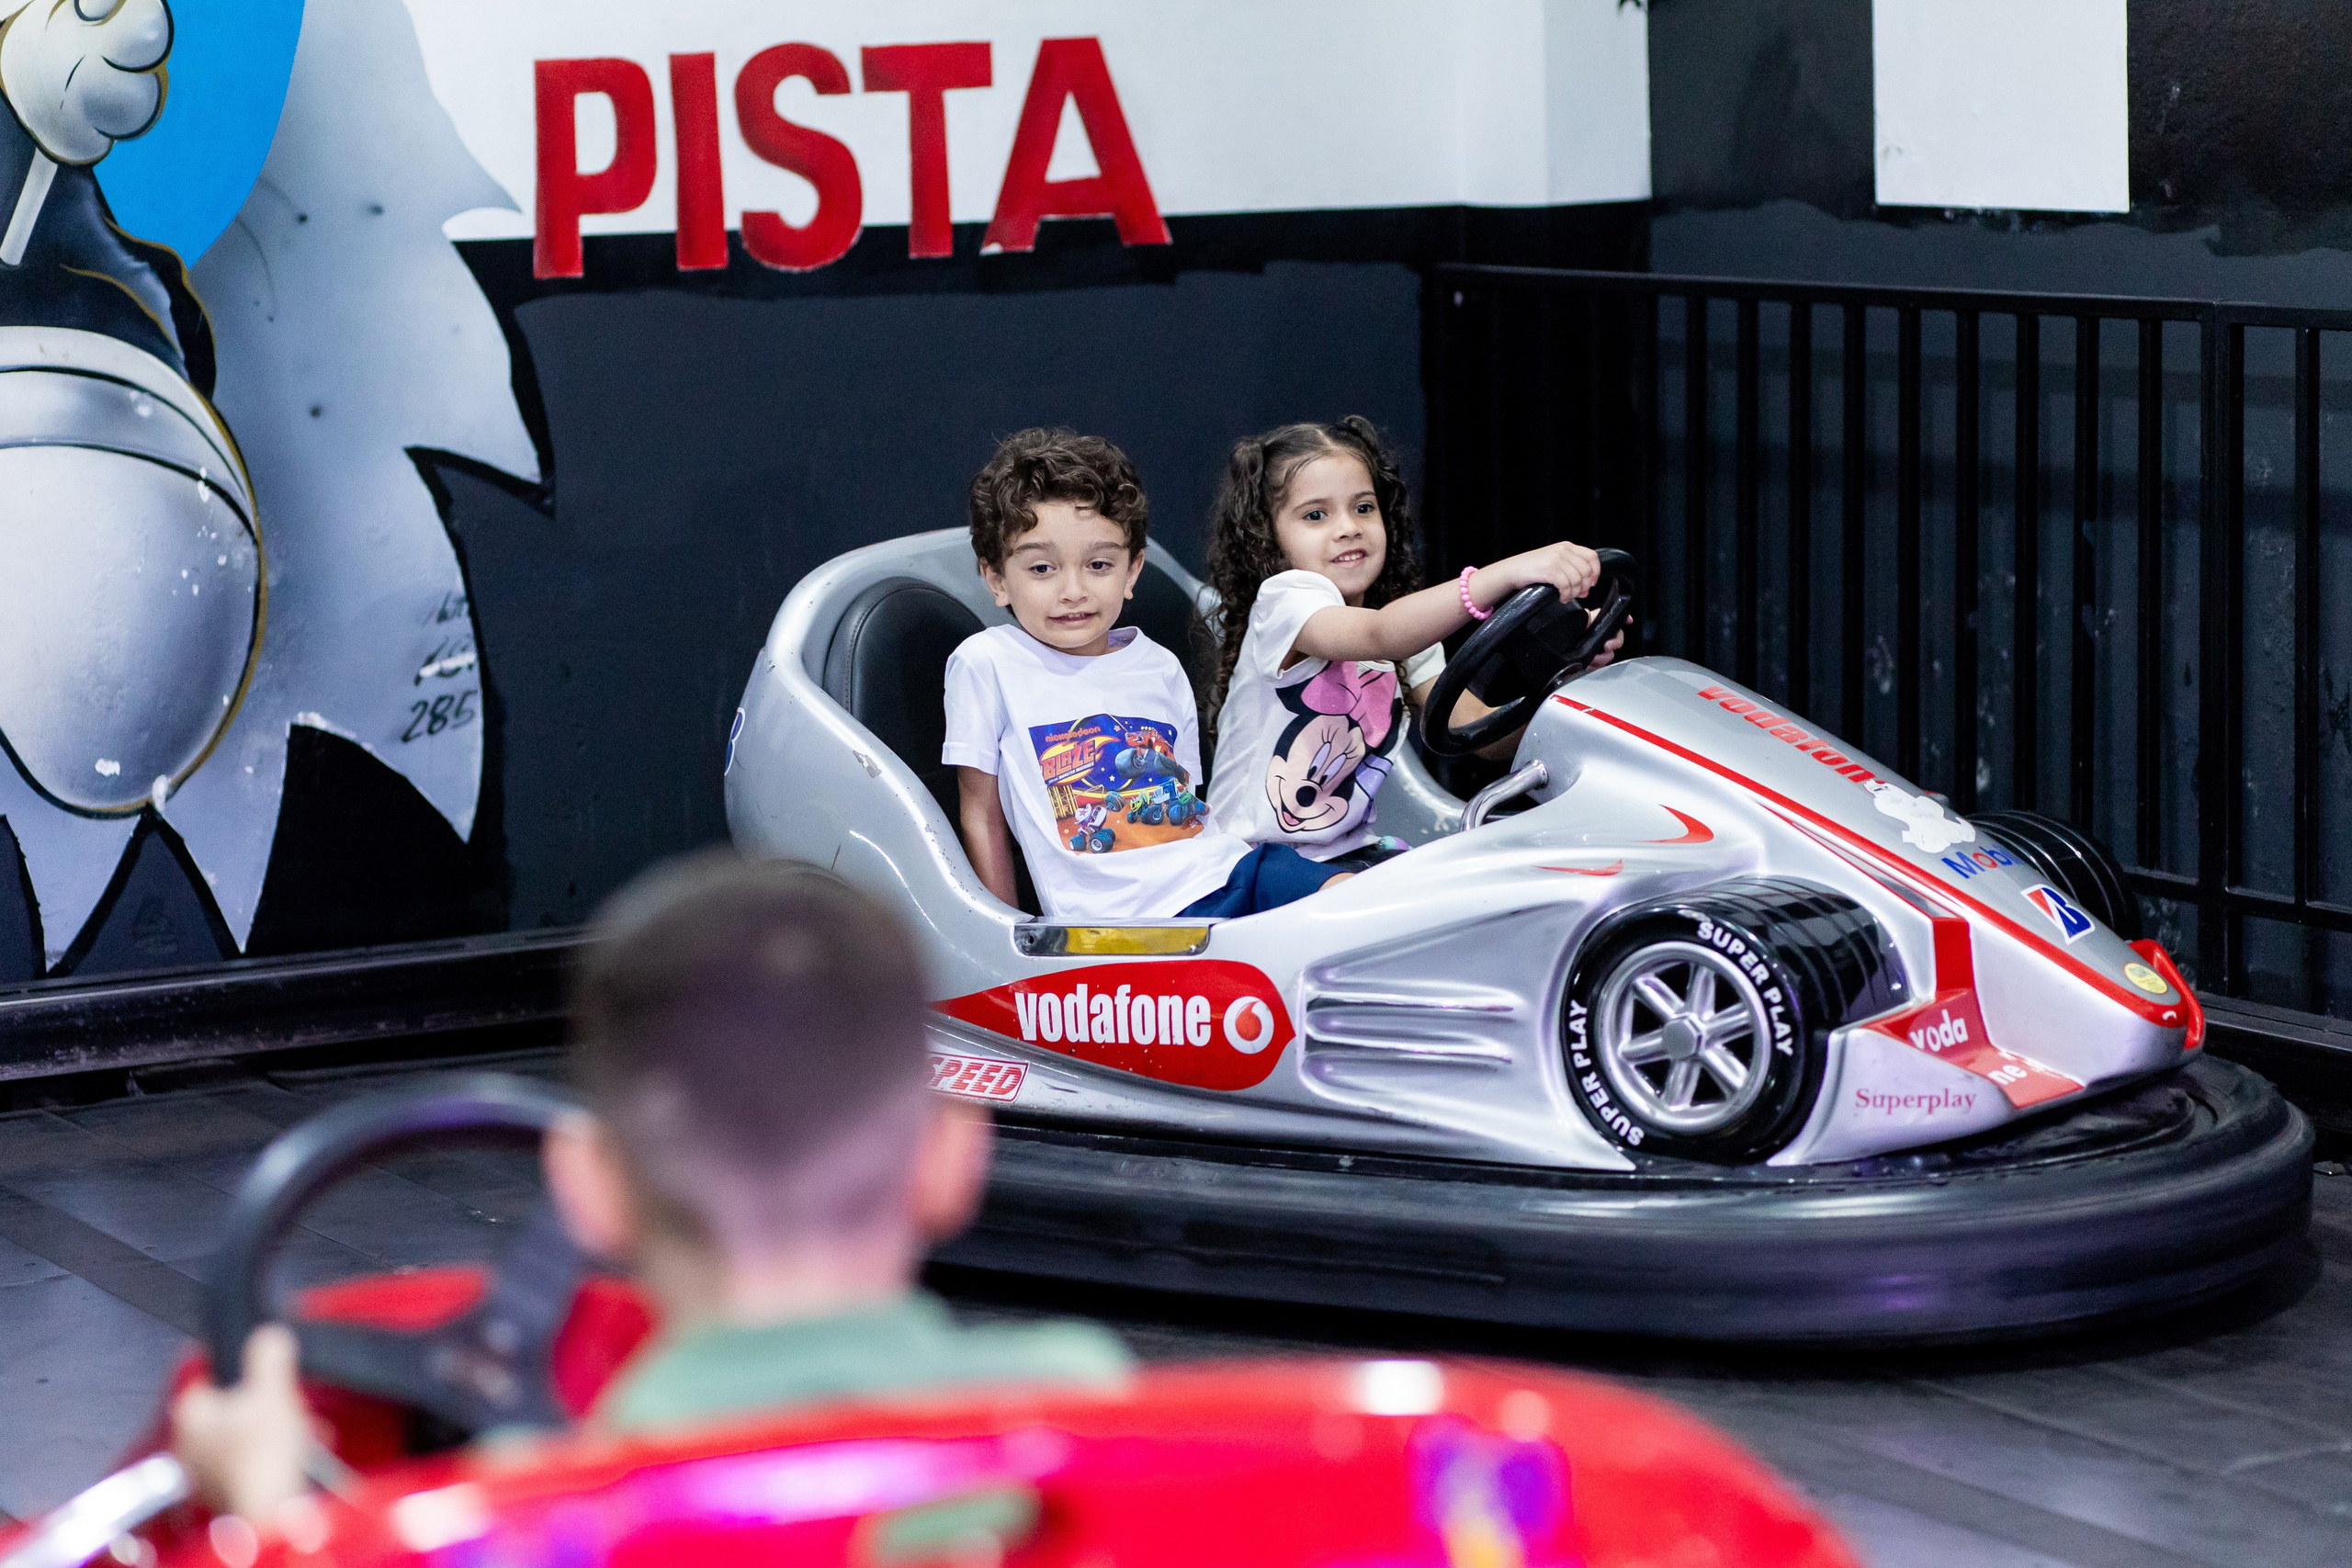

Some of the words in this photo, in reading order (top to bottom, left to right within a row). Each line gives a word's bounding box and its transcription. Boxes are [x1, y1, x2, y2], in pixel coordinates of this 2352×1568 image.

[533, 37, 1172, 279] PISTA
[1042, 739, 1094, 781] BLAZE
[1697, 685, 1886, 788] vodafon
[1014, 983, 1212, 1046] vodafone
[1697, 921, 1770, 986] SUPER
[1763, 987, 1793, 1056] PLAY
[1569, 999, 1591, 1068] PLAY
[1581, 1071, 1645, 1146] SUPER
[1855, 1088, 1976, 1115] Superplay
